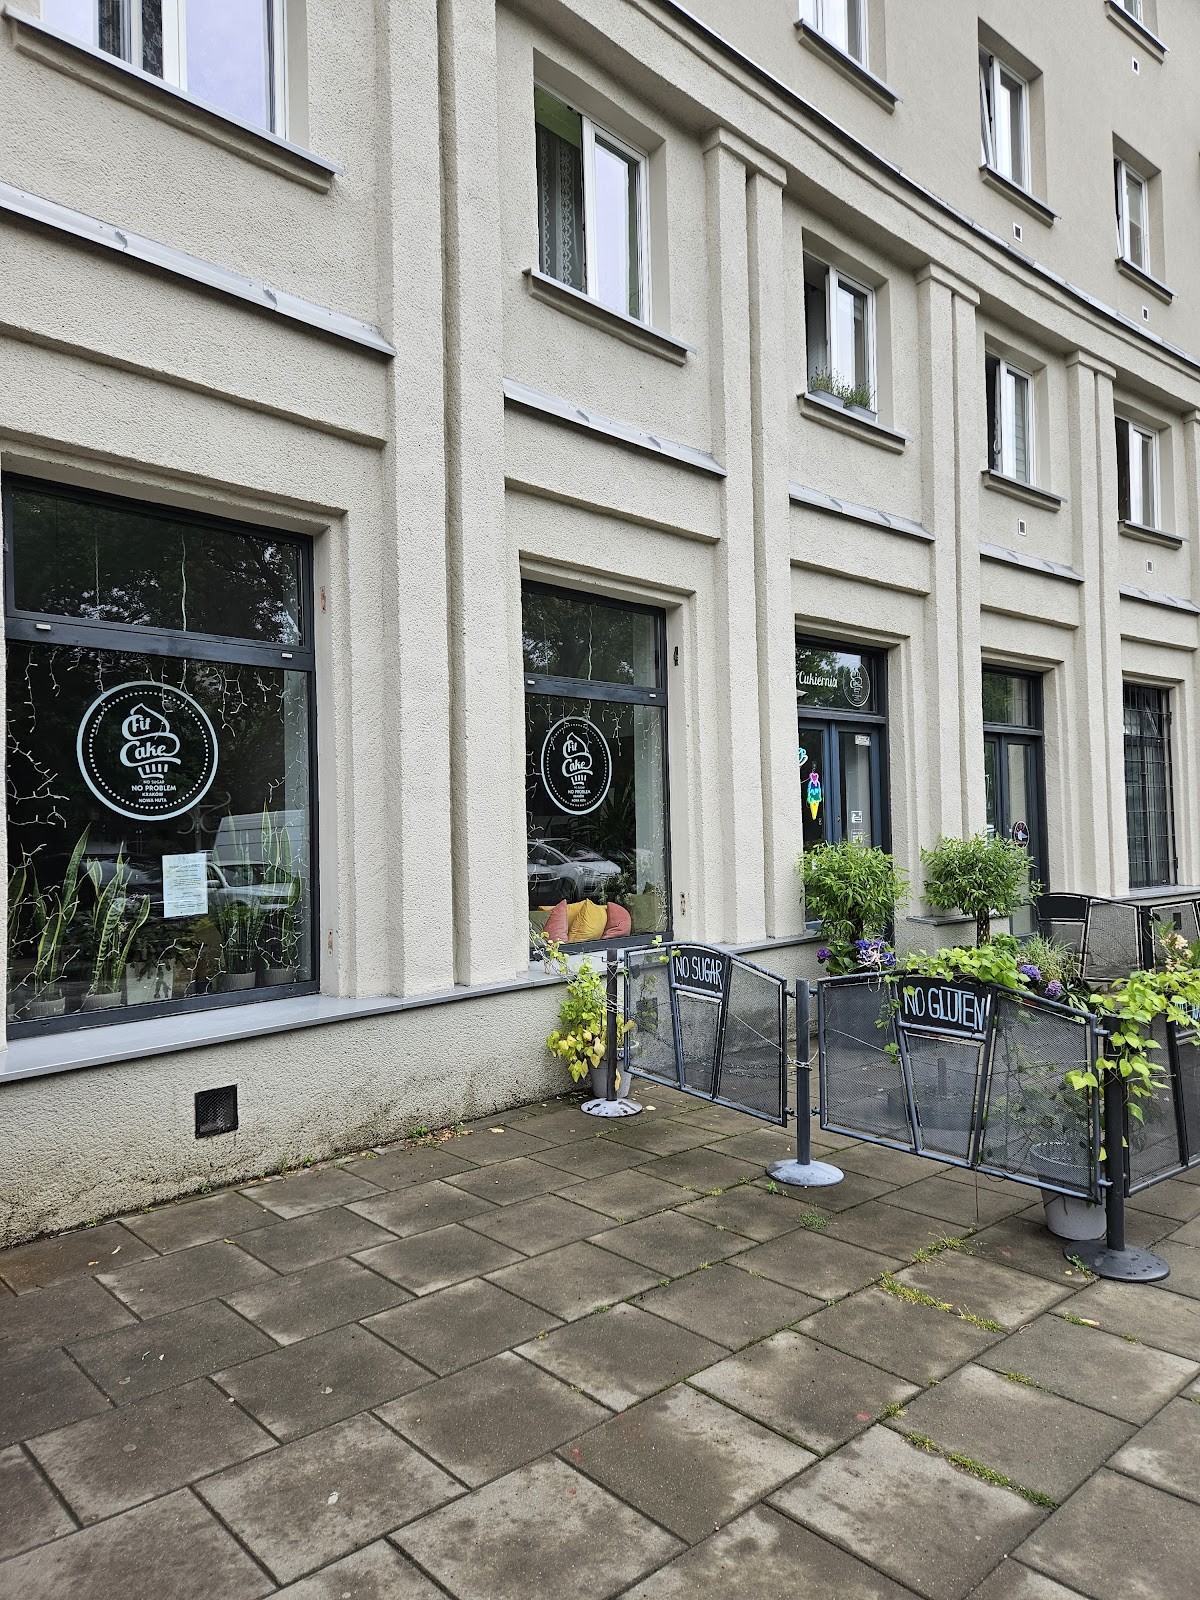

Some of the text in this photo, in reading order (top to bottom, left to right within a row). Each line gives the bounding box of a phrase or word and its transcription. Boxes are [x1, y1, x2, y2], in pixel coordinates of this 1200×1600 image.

[799, 671, 838, 688] Cukiernia
[120, 741, 168, 766] Cake
[562, 758, 587, 777] Cake
[675, 956, 723, 990] NO SUGAR
[903, 986, 986, 1031] NO GLUTEN
